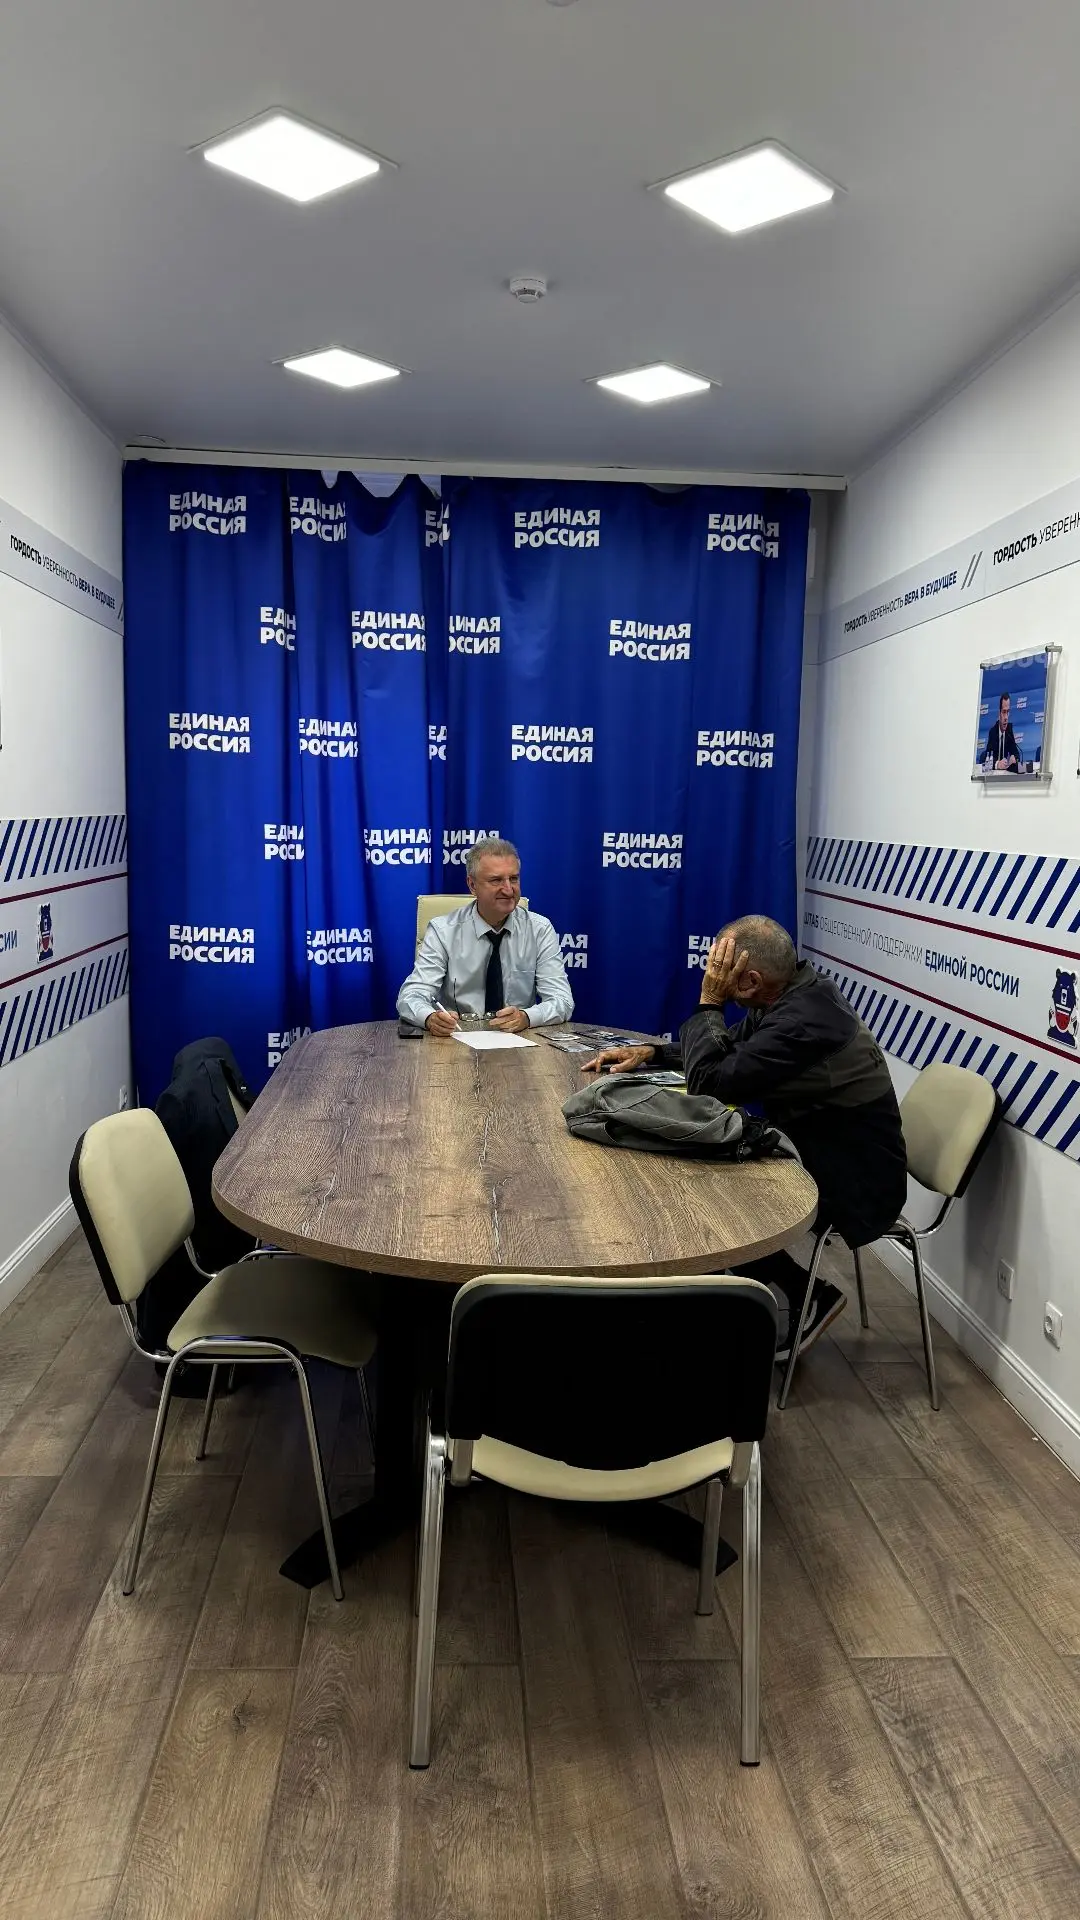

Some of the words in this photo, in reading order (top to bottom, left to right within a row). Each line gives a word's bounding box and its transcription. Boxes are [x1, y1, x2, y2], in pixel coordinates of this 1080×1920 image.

[169, 491, 247, 514] ЕДИНАЯ
[169, 512, 246, 536] РОССИЯ
[514, 507, 600, 529] ЕДИНАЯ
[707, 513, 780, 537] ЕДИНЯ
[514, 527, 600, 549] РОССИЯ
[706, 533, 779, 558] РОССЯ
[993, 533, 1037, 565] ГОРДОСТЬ
[10, 534, 42, 565] ГОРДОСТЬ
[42, 554, 79, 588] УВЕРЕННОСТЬ
[78, 577, 92, 596] ВЕРА
[91, 585, 95, 597] В
[844, 614, 868, 634] ГОРДОСТЬ
[868, 597, 904, 623] УВЕРЕННОСТЬ
[904, 588, 919, 606] ВЕРА
[920, 586, 925, 599] В
[925, 570, 958, 596] БУДУЩЕЕ
[609, 619, 692, 641] ЕДИНАЯ
[608, 639, 691, 661] РОССИЯ
[169, 713, 250, 733] ЕДИНАЯ
[511, 724, 594, 743] ЕДИНАЯ
[169, 732, 251, 753] РОССИЯ
[697, 730, 774, 748] ЕДИНАЯ
[511, 743, 593, 763] РОССИЯ
[696, 749, 774, 768] РОССИЯ
[602, 832, 684, 850] ЕДИНАЯ
[602, 851, 682, 869] РОССИЯ
[169, 924, 255, 944] ЕДИНАЯ
[169, 943, 255, 964] РОССИЯ
[803, 911, 820, 929] ШТАБ
[820, 916, 872, 947] ОБЩЕСТВЕННОЙ
[872, 932, 923, 965] ПОДДЕРЖКИ
[925, 949, 967, 980] ЕДИНОЙ
[970, 963, 1020, 998] РОССИИ
